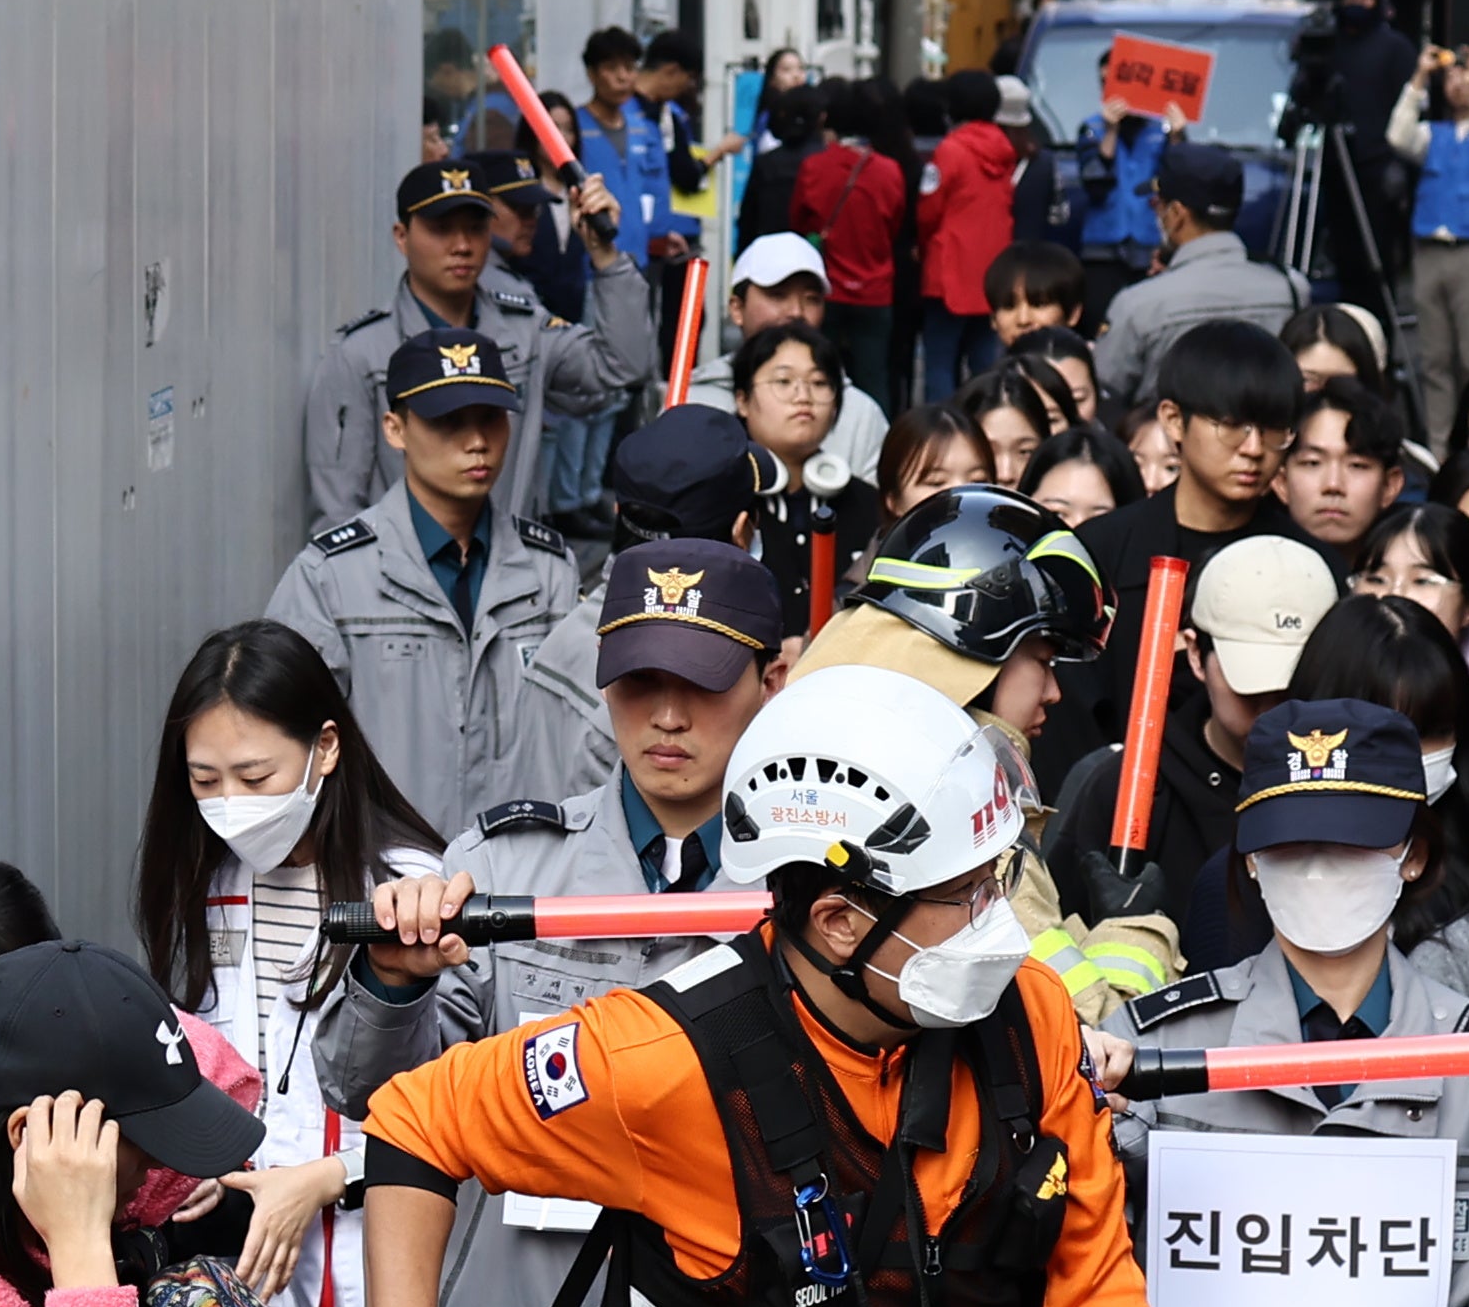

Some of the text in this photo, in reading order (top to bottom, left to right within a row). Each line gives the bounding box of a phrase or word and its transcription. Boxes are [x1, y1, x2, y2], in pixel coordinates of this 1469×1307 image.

[1275, 613, 1303, 630] Lee
[790, 789, 819, 806] 서울
[770, 806, 848, 828] 광진소방서
[525, 1046, 545, 1106] KOREA
[1164, 1209, 1437, 1278] 진입차단
